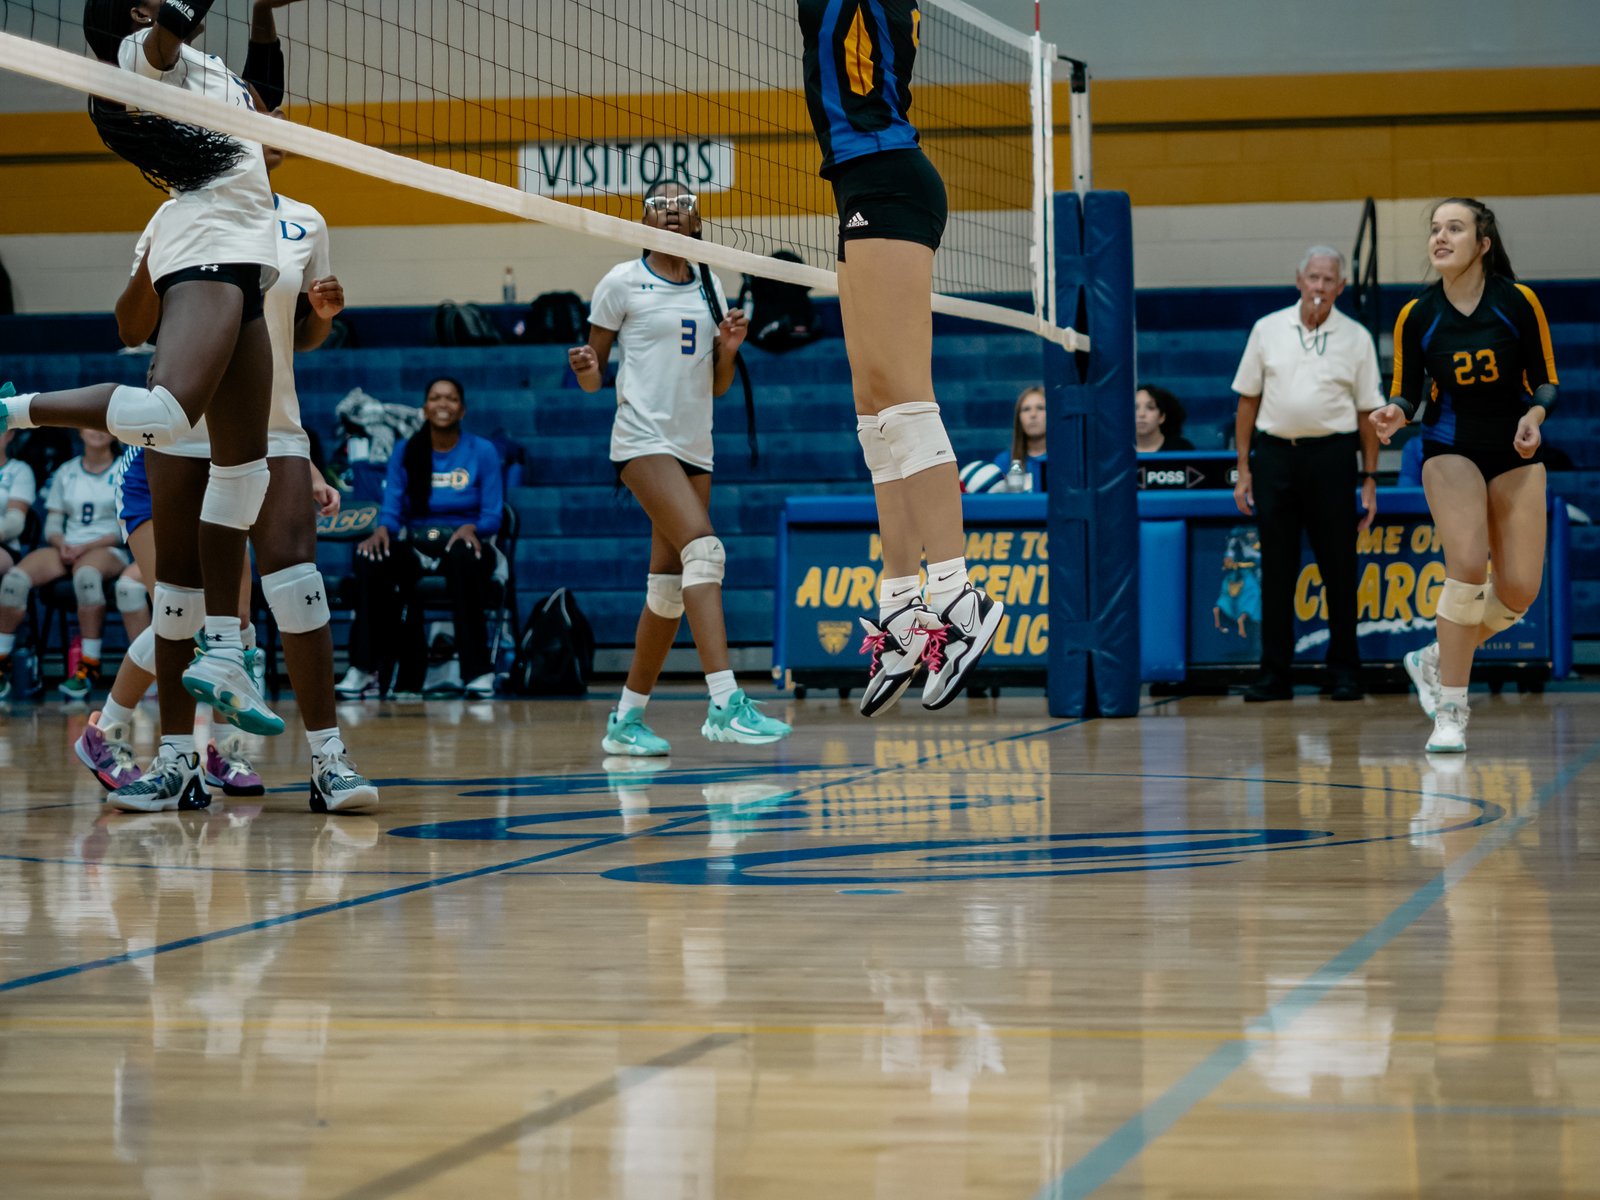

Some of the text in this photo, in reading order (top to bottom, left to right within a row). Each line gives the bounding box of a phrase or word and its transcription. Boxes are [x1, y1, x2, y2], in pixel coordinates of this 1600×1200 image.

[540, 140, 713, 187] VISITORS
[279, 220, 306, 240] D
[681, 319, 697, 355] 3
[1453, 349, 1499, 385] 23
[1147, 470, 1185, 484] POSS
[82, 503, 94, 524] 8
[1356, 527, 1404, 554] ME
[967, 565, 1049, 605] CENT
[1294, 561, 1446, 622] CARG
